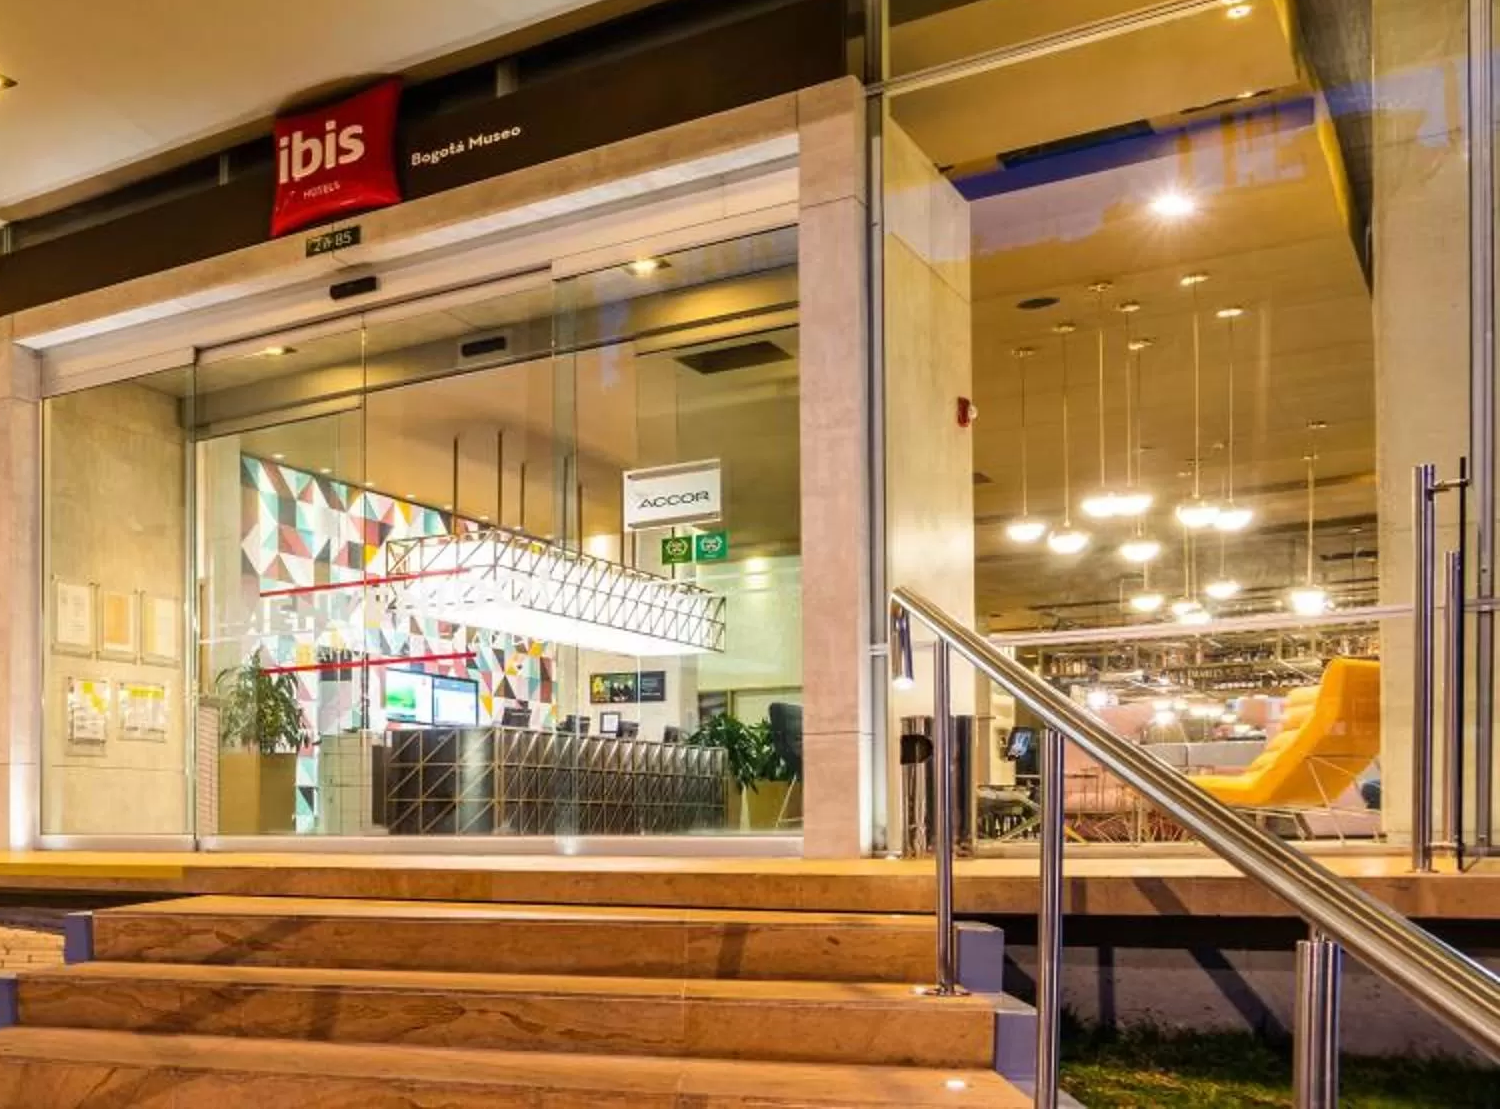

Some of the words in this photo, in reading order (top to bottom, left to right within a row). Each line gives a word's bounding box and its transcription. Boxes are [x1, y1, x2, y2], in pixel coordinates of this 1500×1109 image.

[279, 120, 365, 184] ibis
[411, 143, 465, 166] Bogotá
[468, 126, 521, 150] Museo
[303, 181, 341, 199] HOTELS
[638, 491, 709, 508] ACCOR
